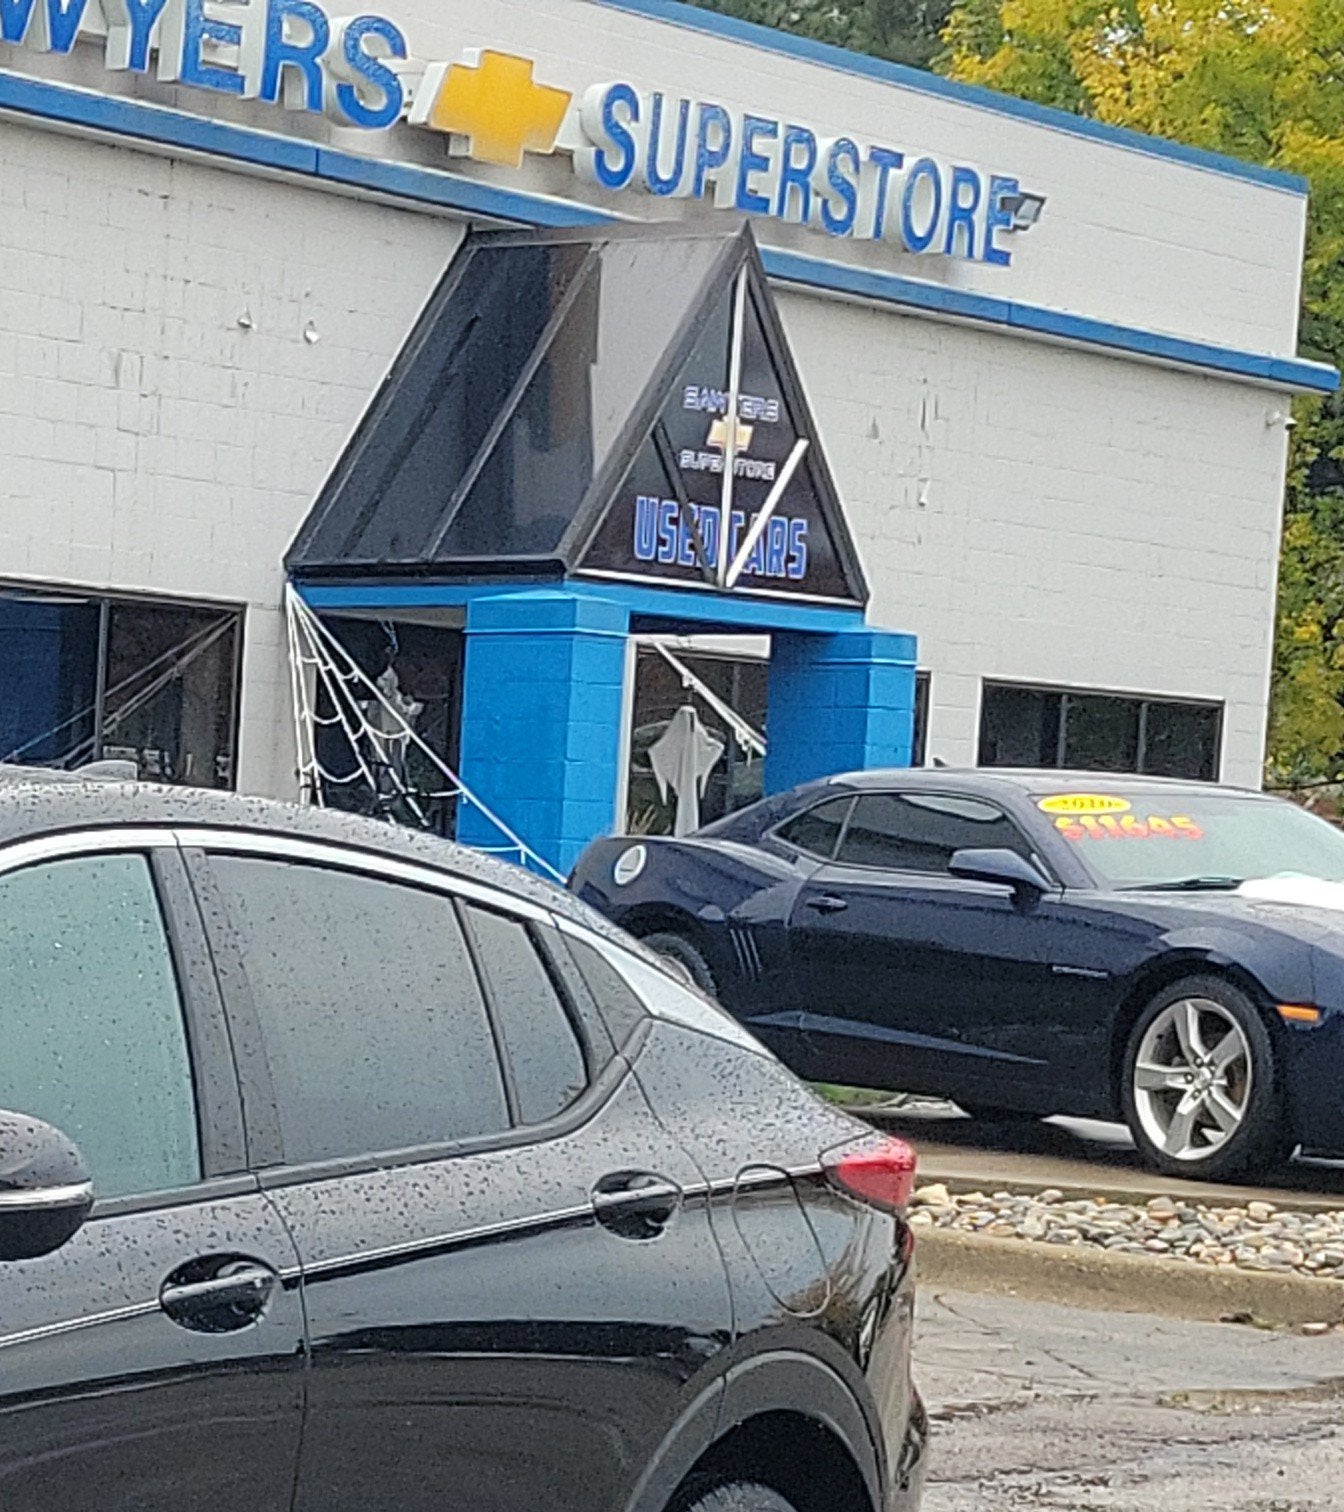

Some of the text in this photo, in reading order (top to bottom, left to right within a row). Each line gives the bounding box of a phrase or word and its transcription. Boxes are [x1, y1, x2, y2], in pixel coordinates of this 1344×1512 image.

[591, 83, 1021, 266] SUPERSTORE
[679, 449, 776, 480] SUPERTORE
[634, 496, 721, 568] USED
